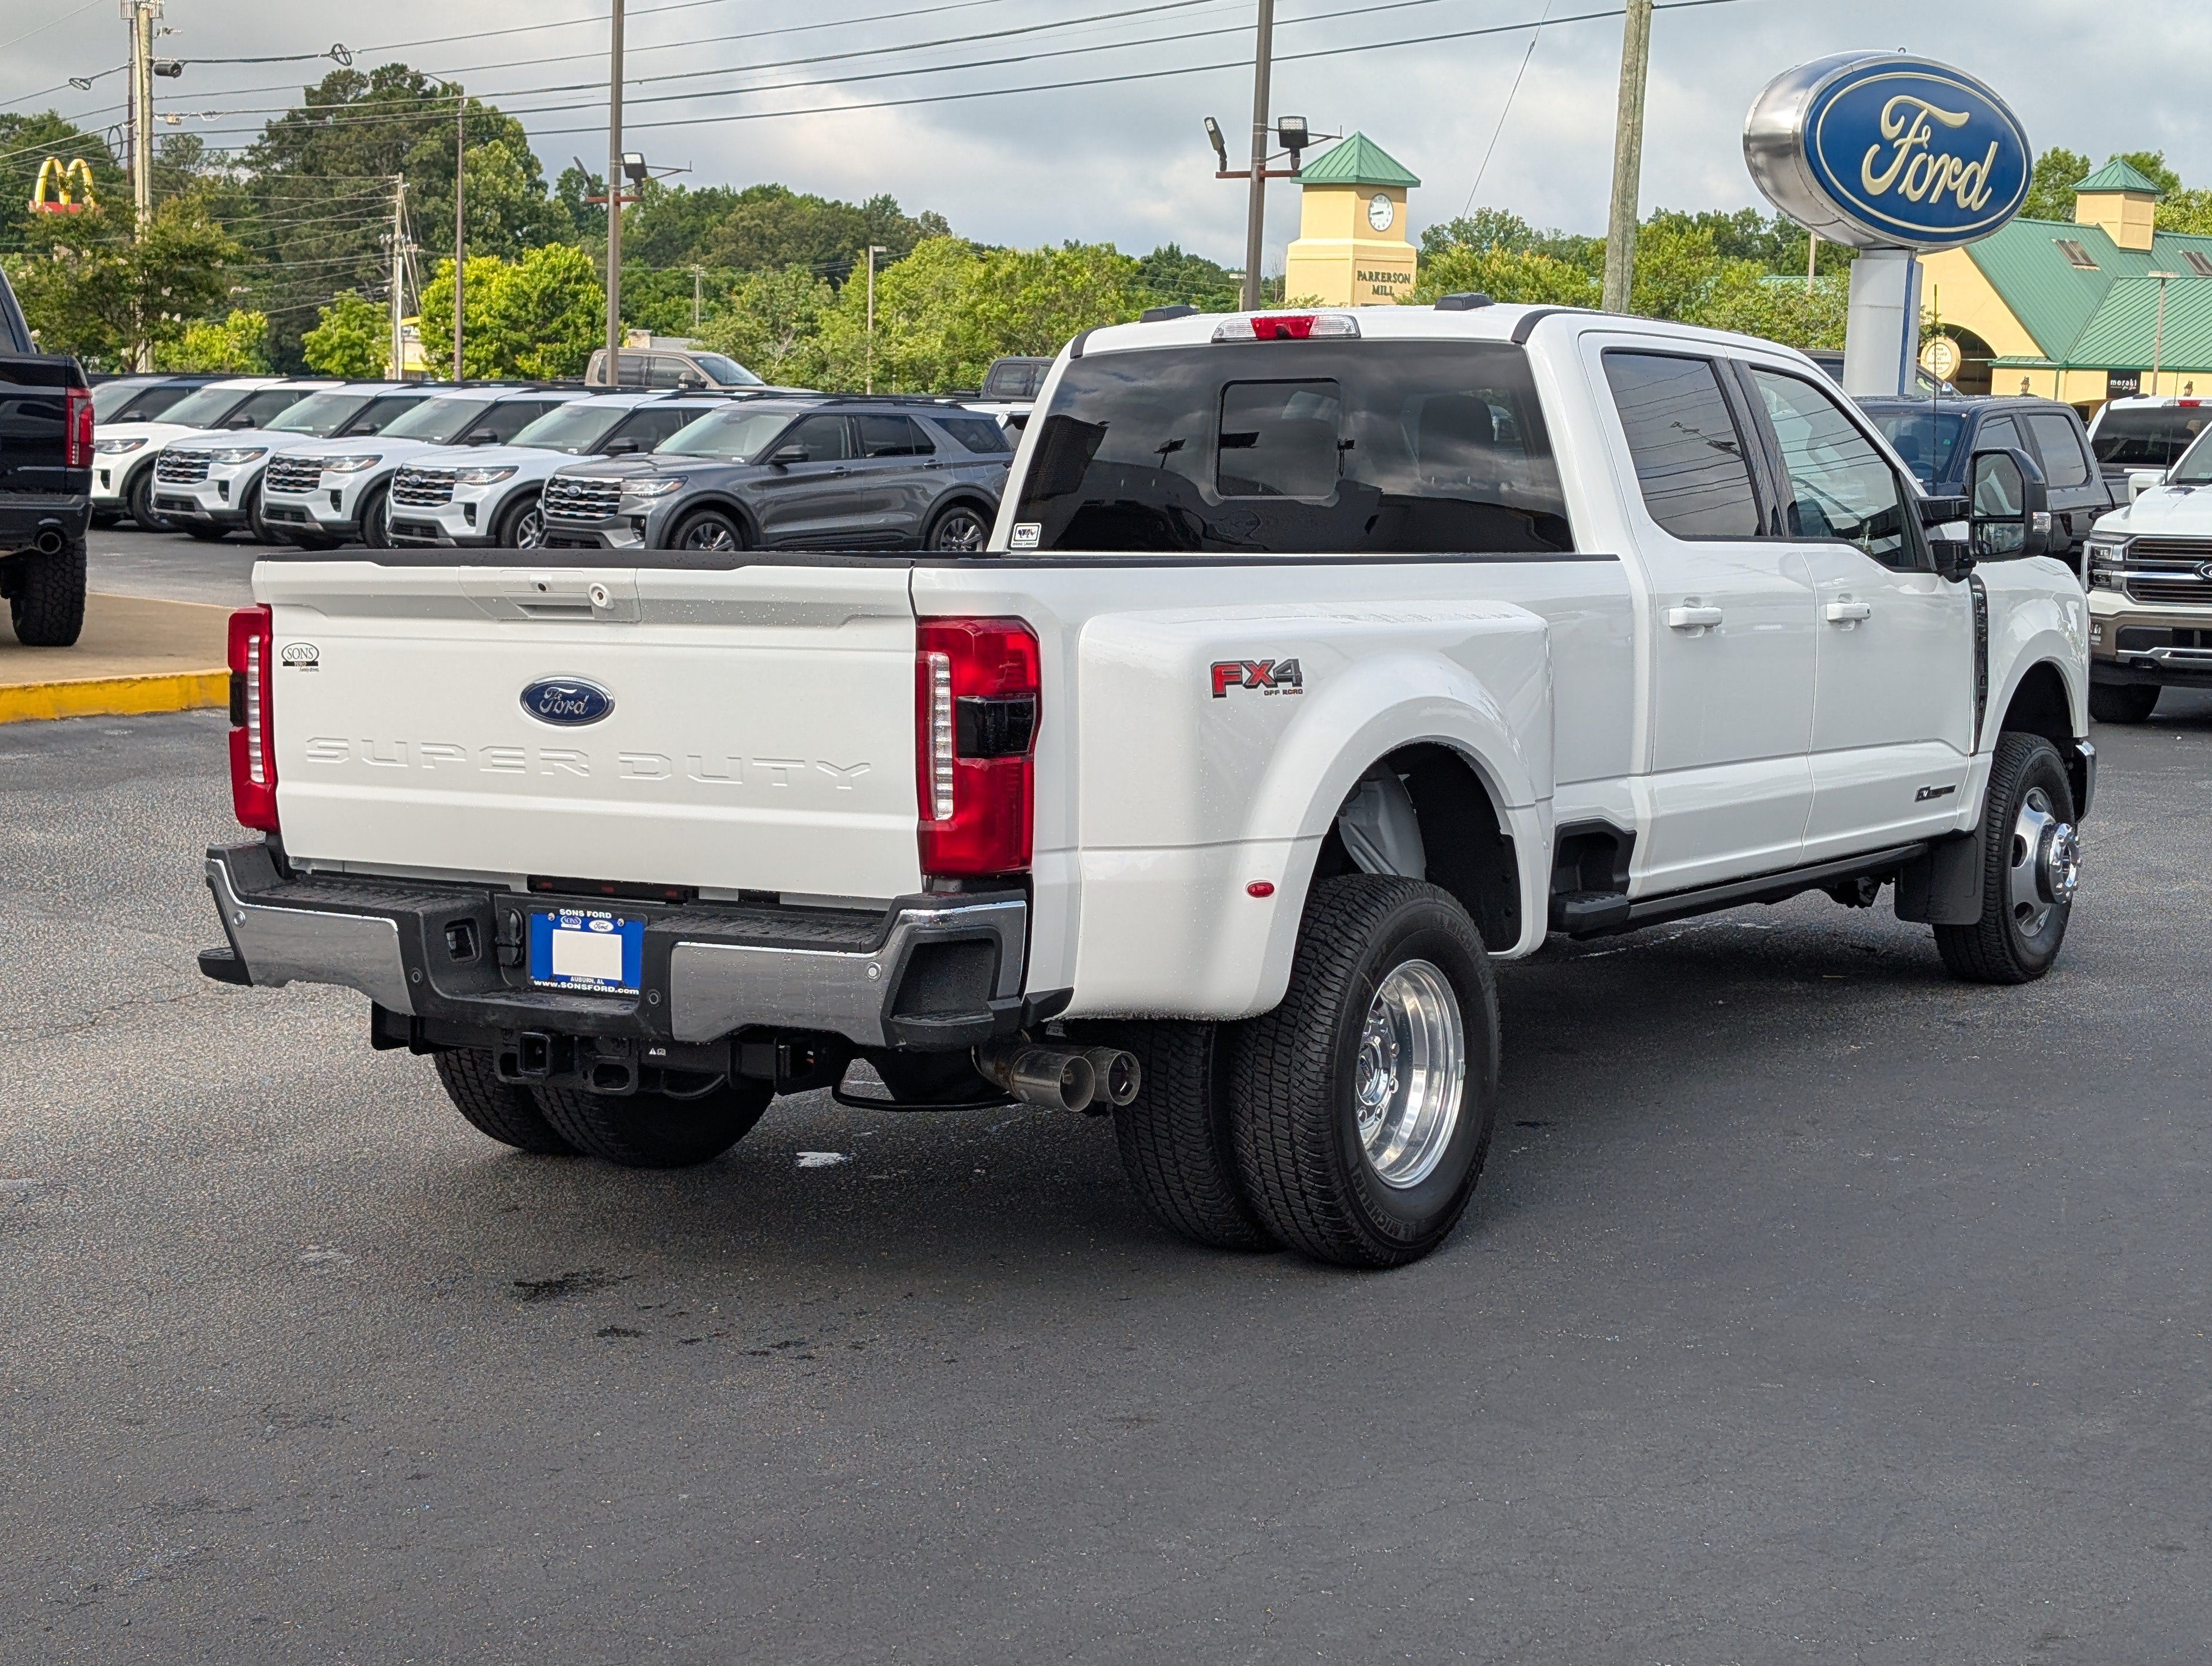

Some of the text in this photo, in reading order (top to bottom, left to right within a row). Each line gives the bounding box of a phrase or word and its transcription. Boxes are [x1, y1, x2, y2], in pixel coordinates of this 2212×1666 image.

[1861, 95, 1998, 211] Ford
[1356, 270, 1411, 284] PARKERSON
[1371, 285, 1394, 296] MILL
[287, 647, 313, 659] SONS
[1210, 658, 1303, 699] FX4
[539, 687, 590, 715] Ford
[306, 737, 871, 790] SUPER DUTY
[560, 908, 612, 919] SONS FORD
[533, 980, 639, 995] www.SONSFORD.com
[1352, 1172, 1403, 1237] MICHELIN
